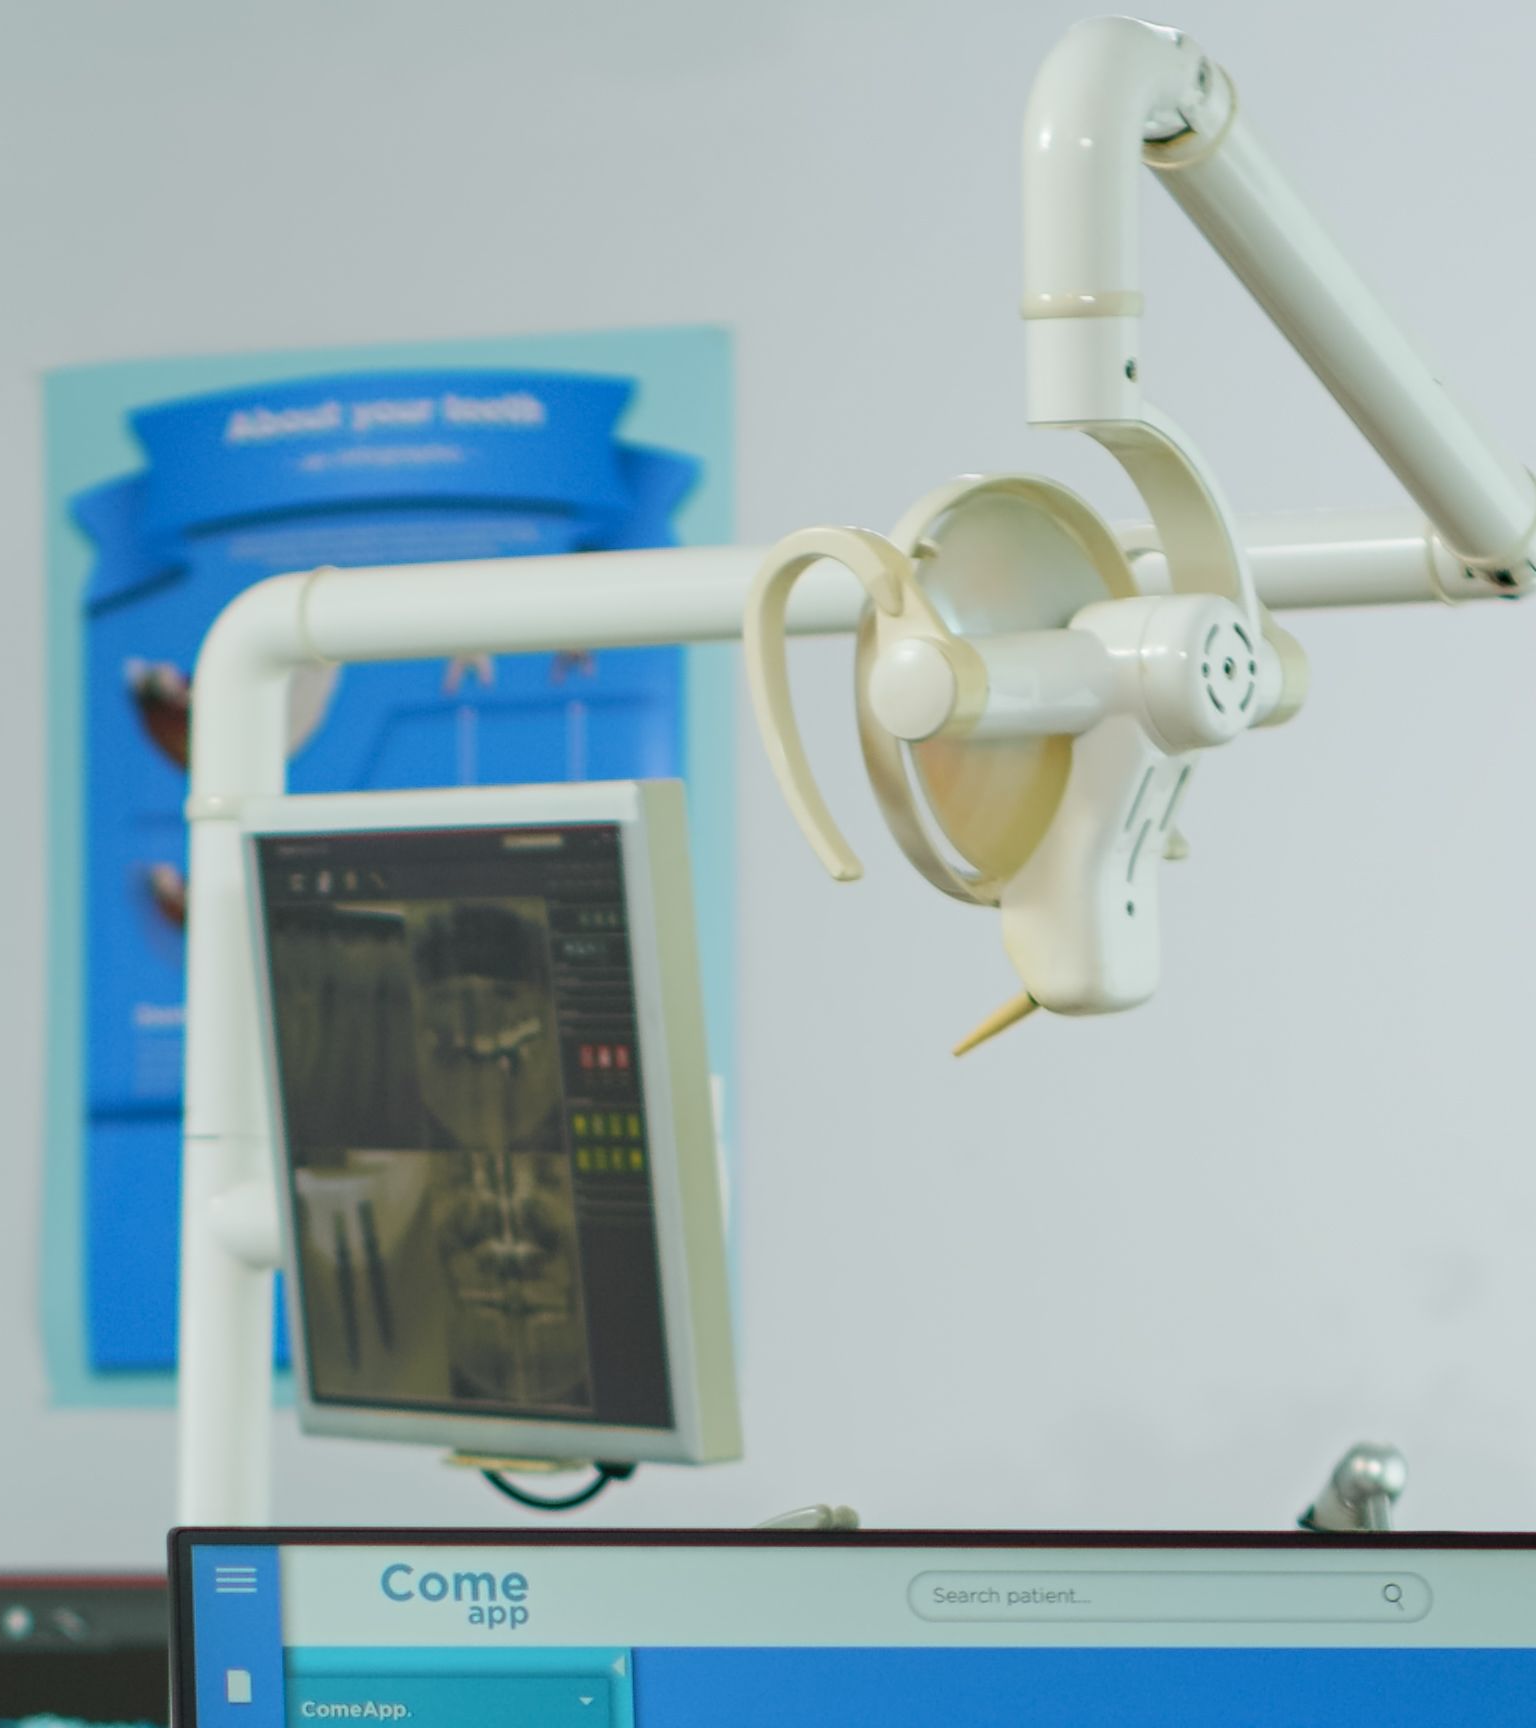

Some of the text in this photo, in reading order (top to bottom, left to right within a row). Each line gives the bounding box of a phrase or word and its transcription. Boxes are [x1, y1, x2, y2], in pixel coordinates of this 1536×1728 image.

[380, 1563, 529, 1603] Come
[932, 1586, 1002, 1605] Search
[467, 1605, 530, 1630] app
[301, 1700, 412, 1721] ComeApp.
